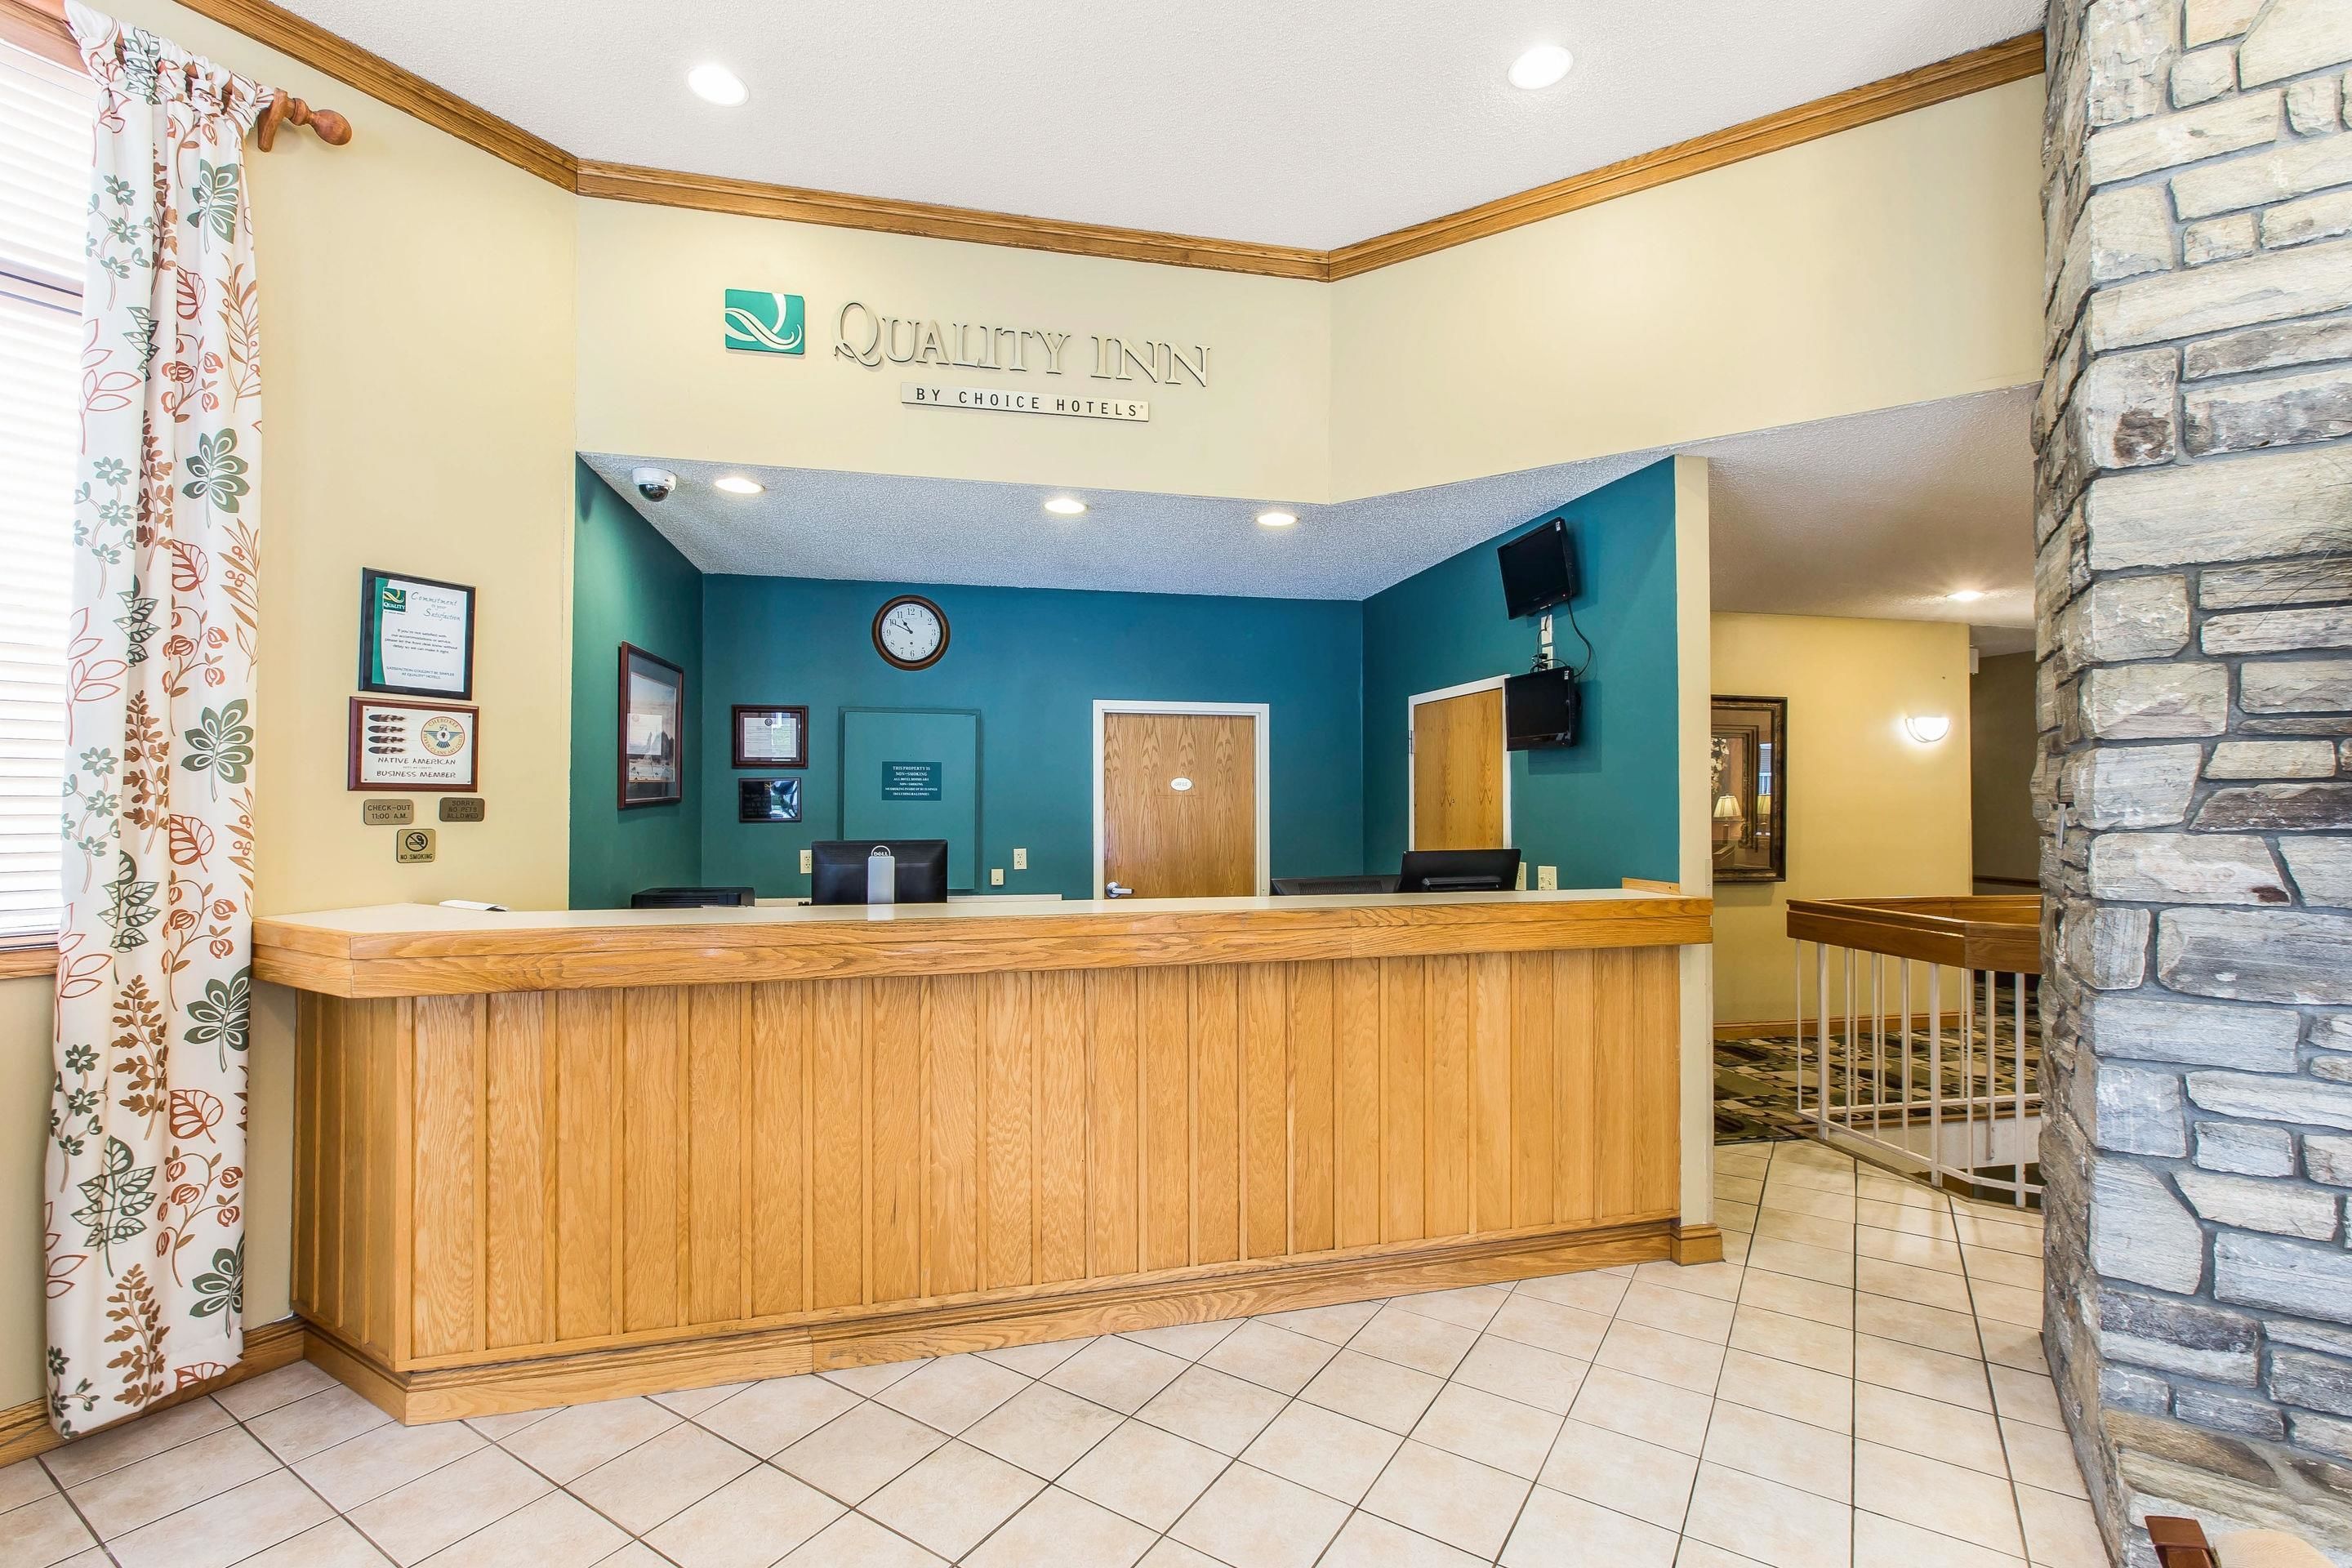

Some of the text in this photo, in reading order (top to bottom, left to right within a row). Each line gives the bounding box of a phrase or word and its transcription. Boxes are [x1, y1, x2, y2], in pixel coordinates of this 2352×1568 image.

[834, 301, 1210, 388] QUALITY INN
[916, 388, 1137, 417] BY CHOICE HOTELS
[411, 592, 457, 605] Commitment
[424, 608, 461, 621] Satisfaction
[897, 611, 903, 619] 11
[889, 618, 897, 626] 10
[428, 718, 459, 728] CHEROKEE
